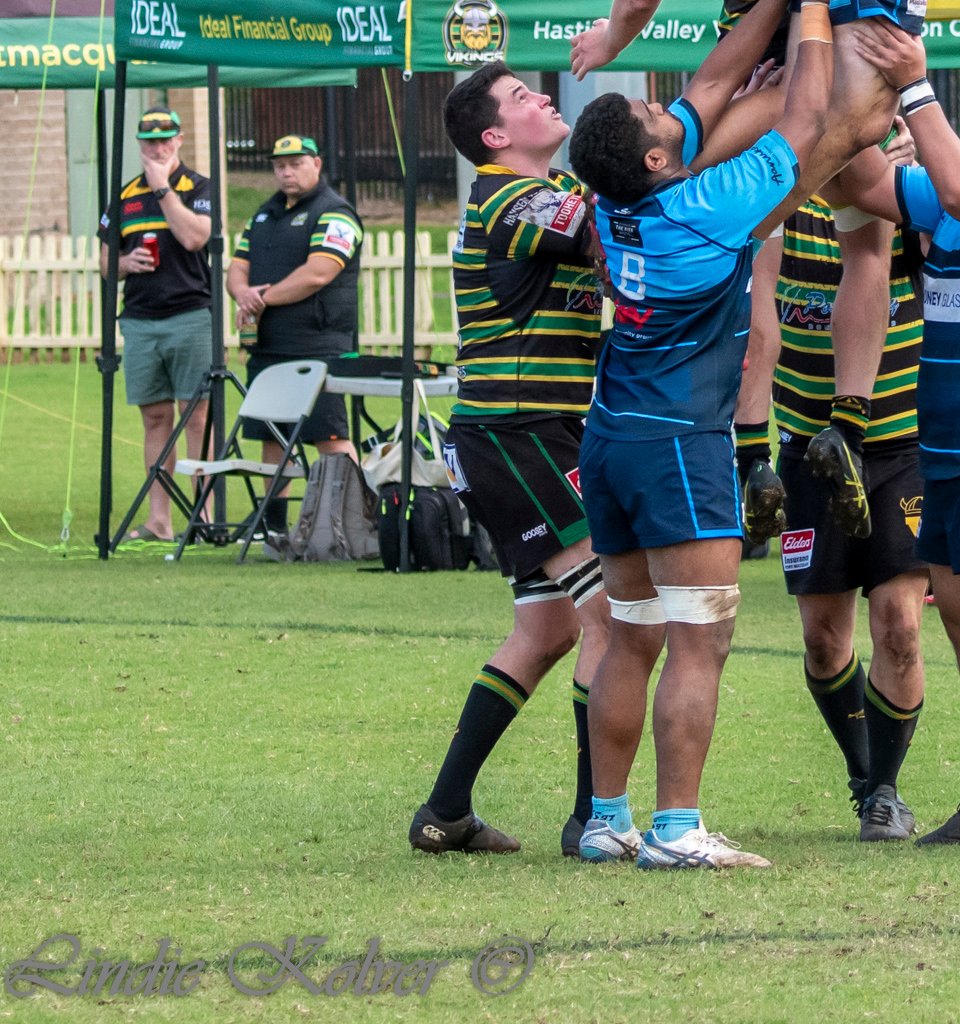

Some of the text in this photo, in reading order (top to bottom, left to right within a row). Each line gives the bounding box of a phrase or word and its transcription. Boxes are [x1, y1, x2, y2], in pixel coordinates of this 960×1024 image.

[130, 0, 186, 37] IDEAL
[199, 14, 333, 46] Ideal Financial Group
[336, 6, 392, 42] IDEAL
[447, 51, 504, 63] VIKINGS
[619, 251, 646, 301] 8
[521, 522, 546, 542] GOOSEY
